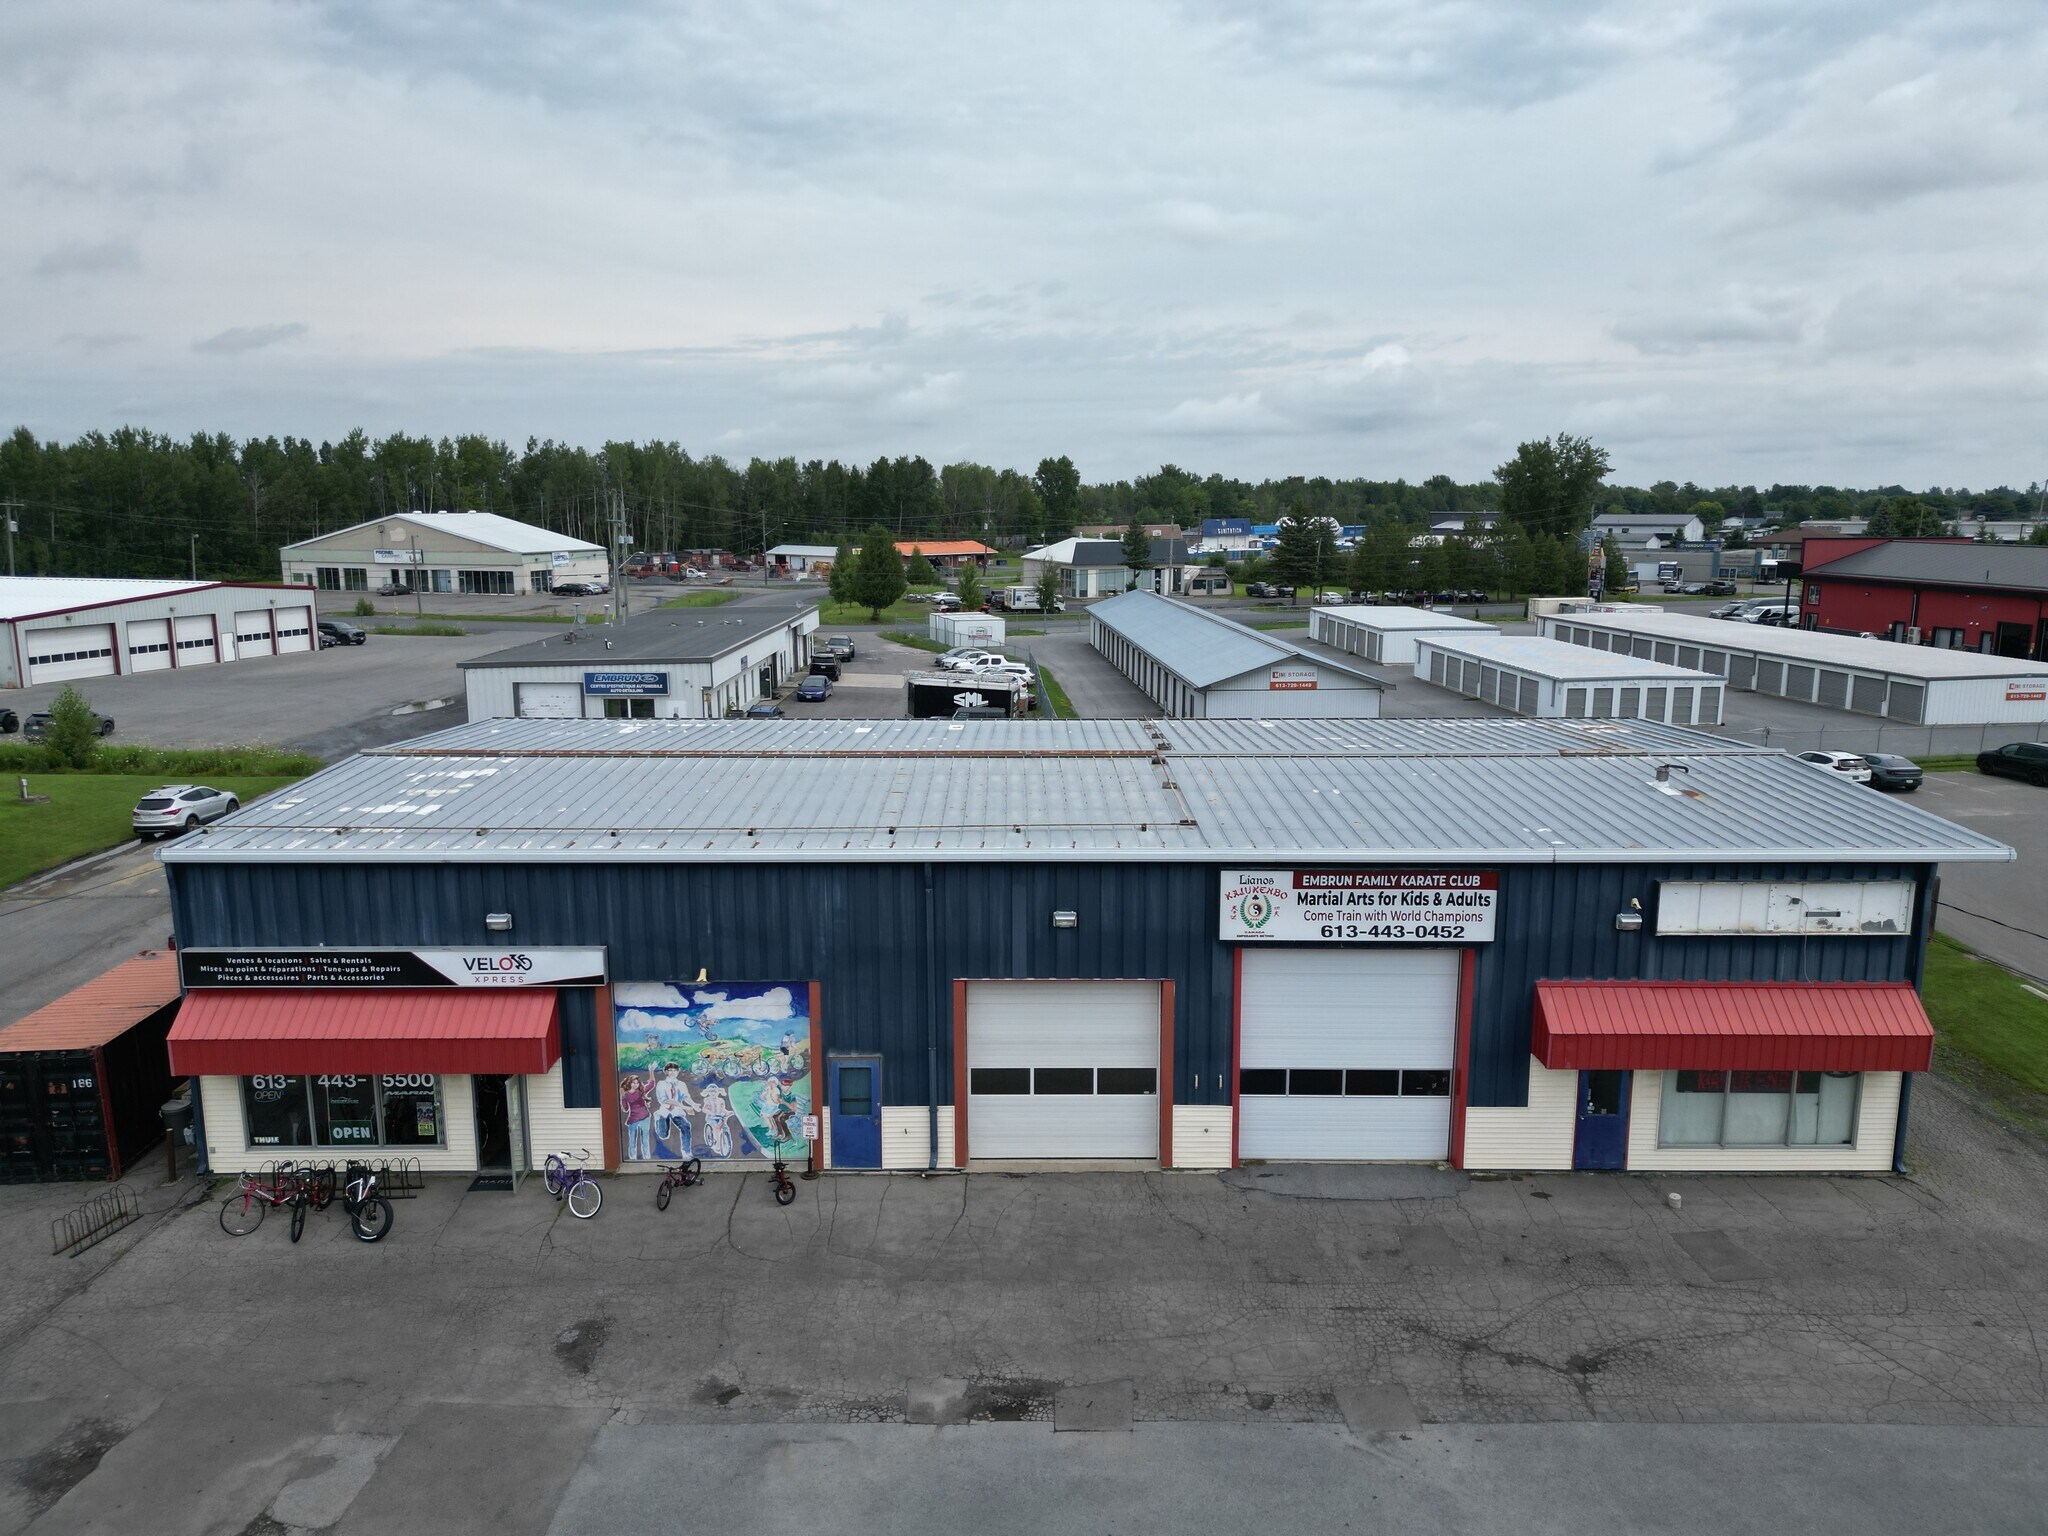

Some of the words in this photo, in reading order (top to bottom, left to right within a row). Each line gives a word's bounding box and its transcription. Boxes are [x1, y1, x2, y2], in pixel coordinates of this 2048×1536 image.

[594, 674, 641, 682] EMBRUN
[1239, 874, 1275, 885] Lianos
[1302, 875, 1353, 886] EMBRUN
[1355, 875, 1398, 886] FAMILY
[1400, 875, 1447, 887] KARATE
[1449, 875, 1481, 887] CLUB
[1224, 886, 1288, 901] KAJUKENBO
[1297, 890, 1343, 906] Martial
[1346, 891, 1375, 906] Arts
[1378, 891, 1397, 906] for
[1400, 890, 1430, 906] Kids
[1433, 892, 1442, 906] &
[1445, 891, 1491, 907] Adults
[1303, 910, 1333, 921] Come
[1336, 909, 1361, 921] Train
[1364, 909, 1387, 921] with
[1390, 910, 1421, 922] World
[1424, 910, 1483, 924] Champions
[1320, 925, 1465, 939] 613-443-0452
[268, 965, 316, 973] réparations
[323, 966, 360, 974] Tune-ups
[370, 965, 401, 973] Repairs
[252, 1074, 297, 1089] 613-
[317, 1074, 367, 1088] 443-
[382, 1073, 435, 1087] 5500
[254, 1091, 282, 1100] OPEN
[332, 1126, 371, 1139] OPEN
[254, 1136, 280, 1144] THULE
